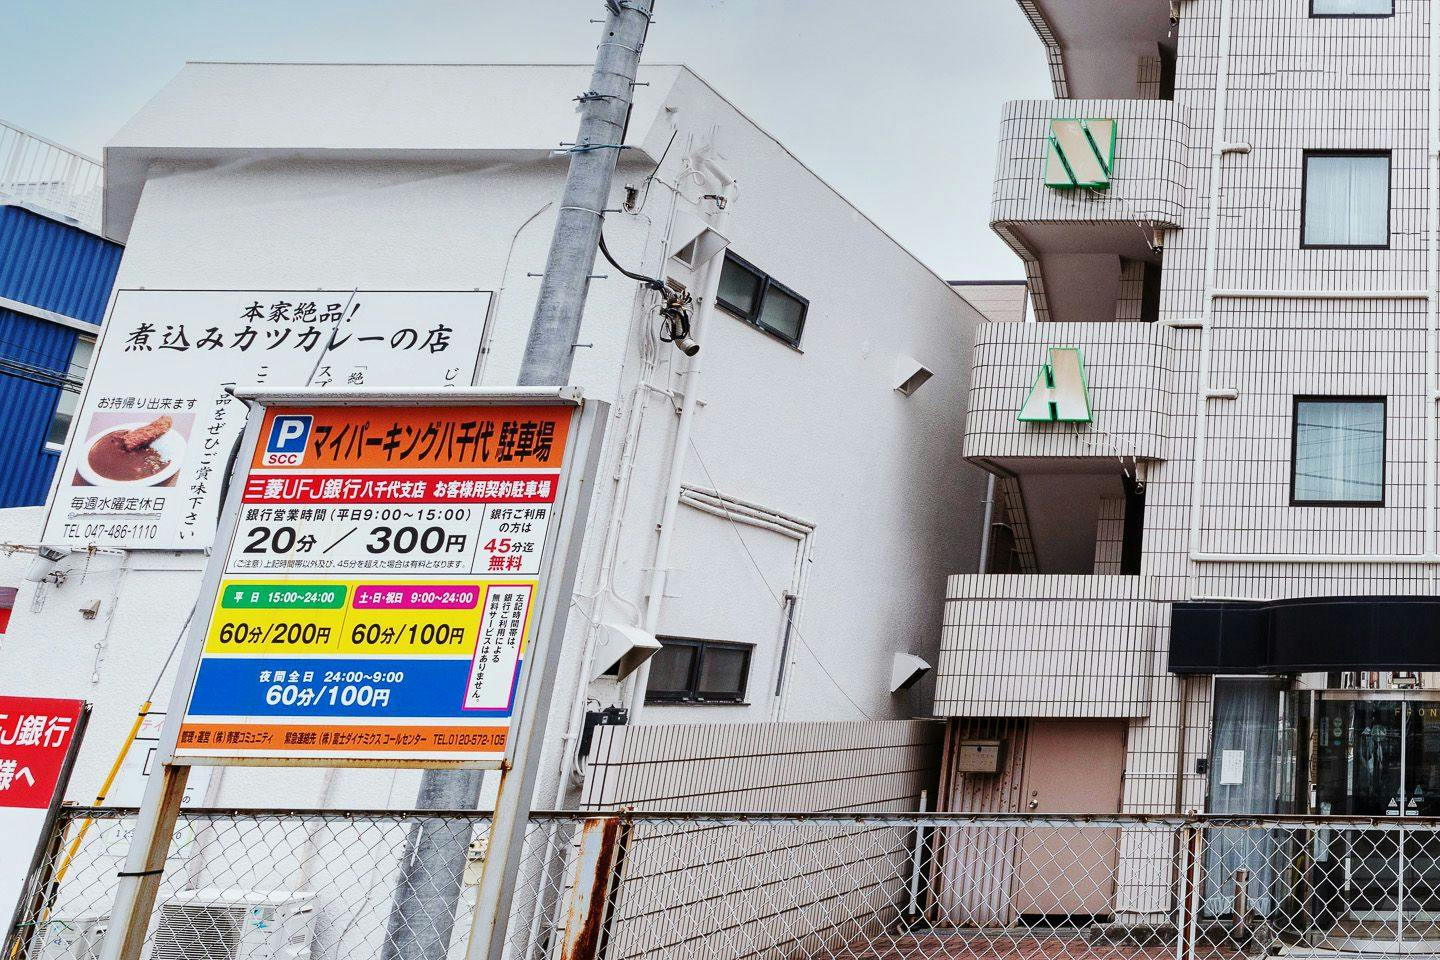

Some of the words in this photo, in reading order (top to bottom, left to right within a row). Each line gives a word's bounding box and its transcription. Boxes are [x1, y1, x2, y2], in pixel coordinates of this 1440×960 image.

[239, 300, 361, 324] 本家絶品!
[123, 322, 453, 354] 煮込みカツカレーの店
[96, 397, 198, 411] お持帰り出来ます
[276, 419, 305, 449] P
[313, 420, 494, 463] マイパーキング八千代
[496, 420, 556, 464] 駐車場
[267, 453, 298, 465] SCC
[433, 480, 552, 499] お客様用契約駐車場
[69, 496, 166, 512] 毎週水曜定休日
[489, 508, 547, 521] 銀行ご利用
[62, 524, 80, 538] TEL
[84, 523, 158, 539] 047-486-1110
[499, 521, 533, 534] の方は
[242, 525, 317, 555] 20分
[366, 525, 468, 555] 300円
[483, 537, 535, 554] 45分迄
[487, 555, 523, 572] 無料
[267, 591, 335, 604] 15:00~24:00
[410, 591, 474, 604] 9:00~24:00
[491, 593, 513, 664] 銀行ご利用による
[506, 593, 525, 649] 左記時間帯は、
[218, 622, 332, 645] 60分/200円
[351, 623, 465, 646] 60分/100円
[471, 593, 501, 703] 無料サービスはありません。
[258, 670, 315, 683] 夜間全日
[323, 671, 404, 683] 24:00~9:00
[265, 684, 391, 708] 60分/100円
[433, 733, 506, 747] TEL.0120-572-105
